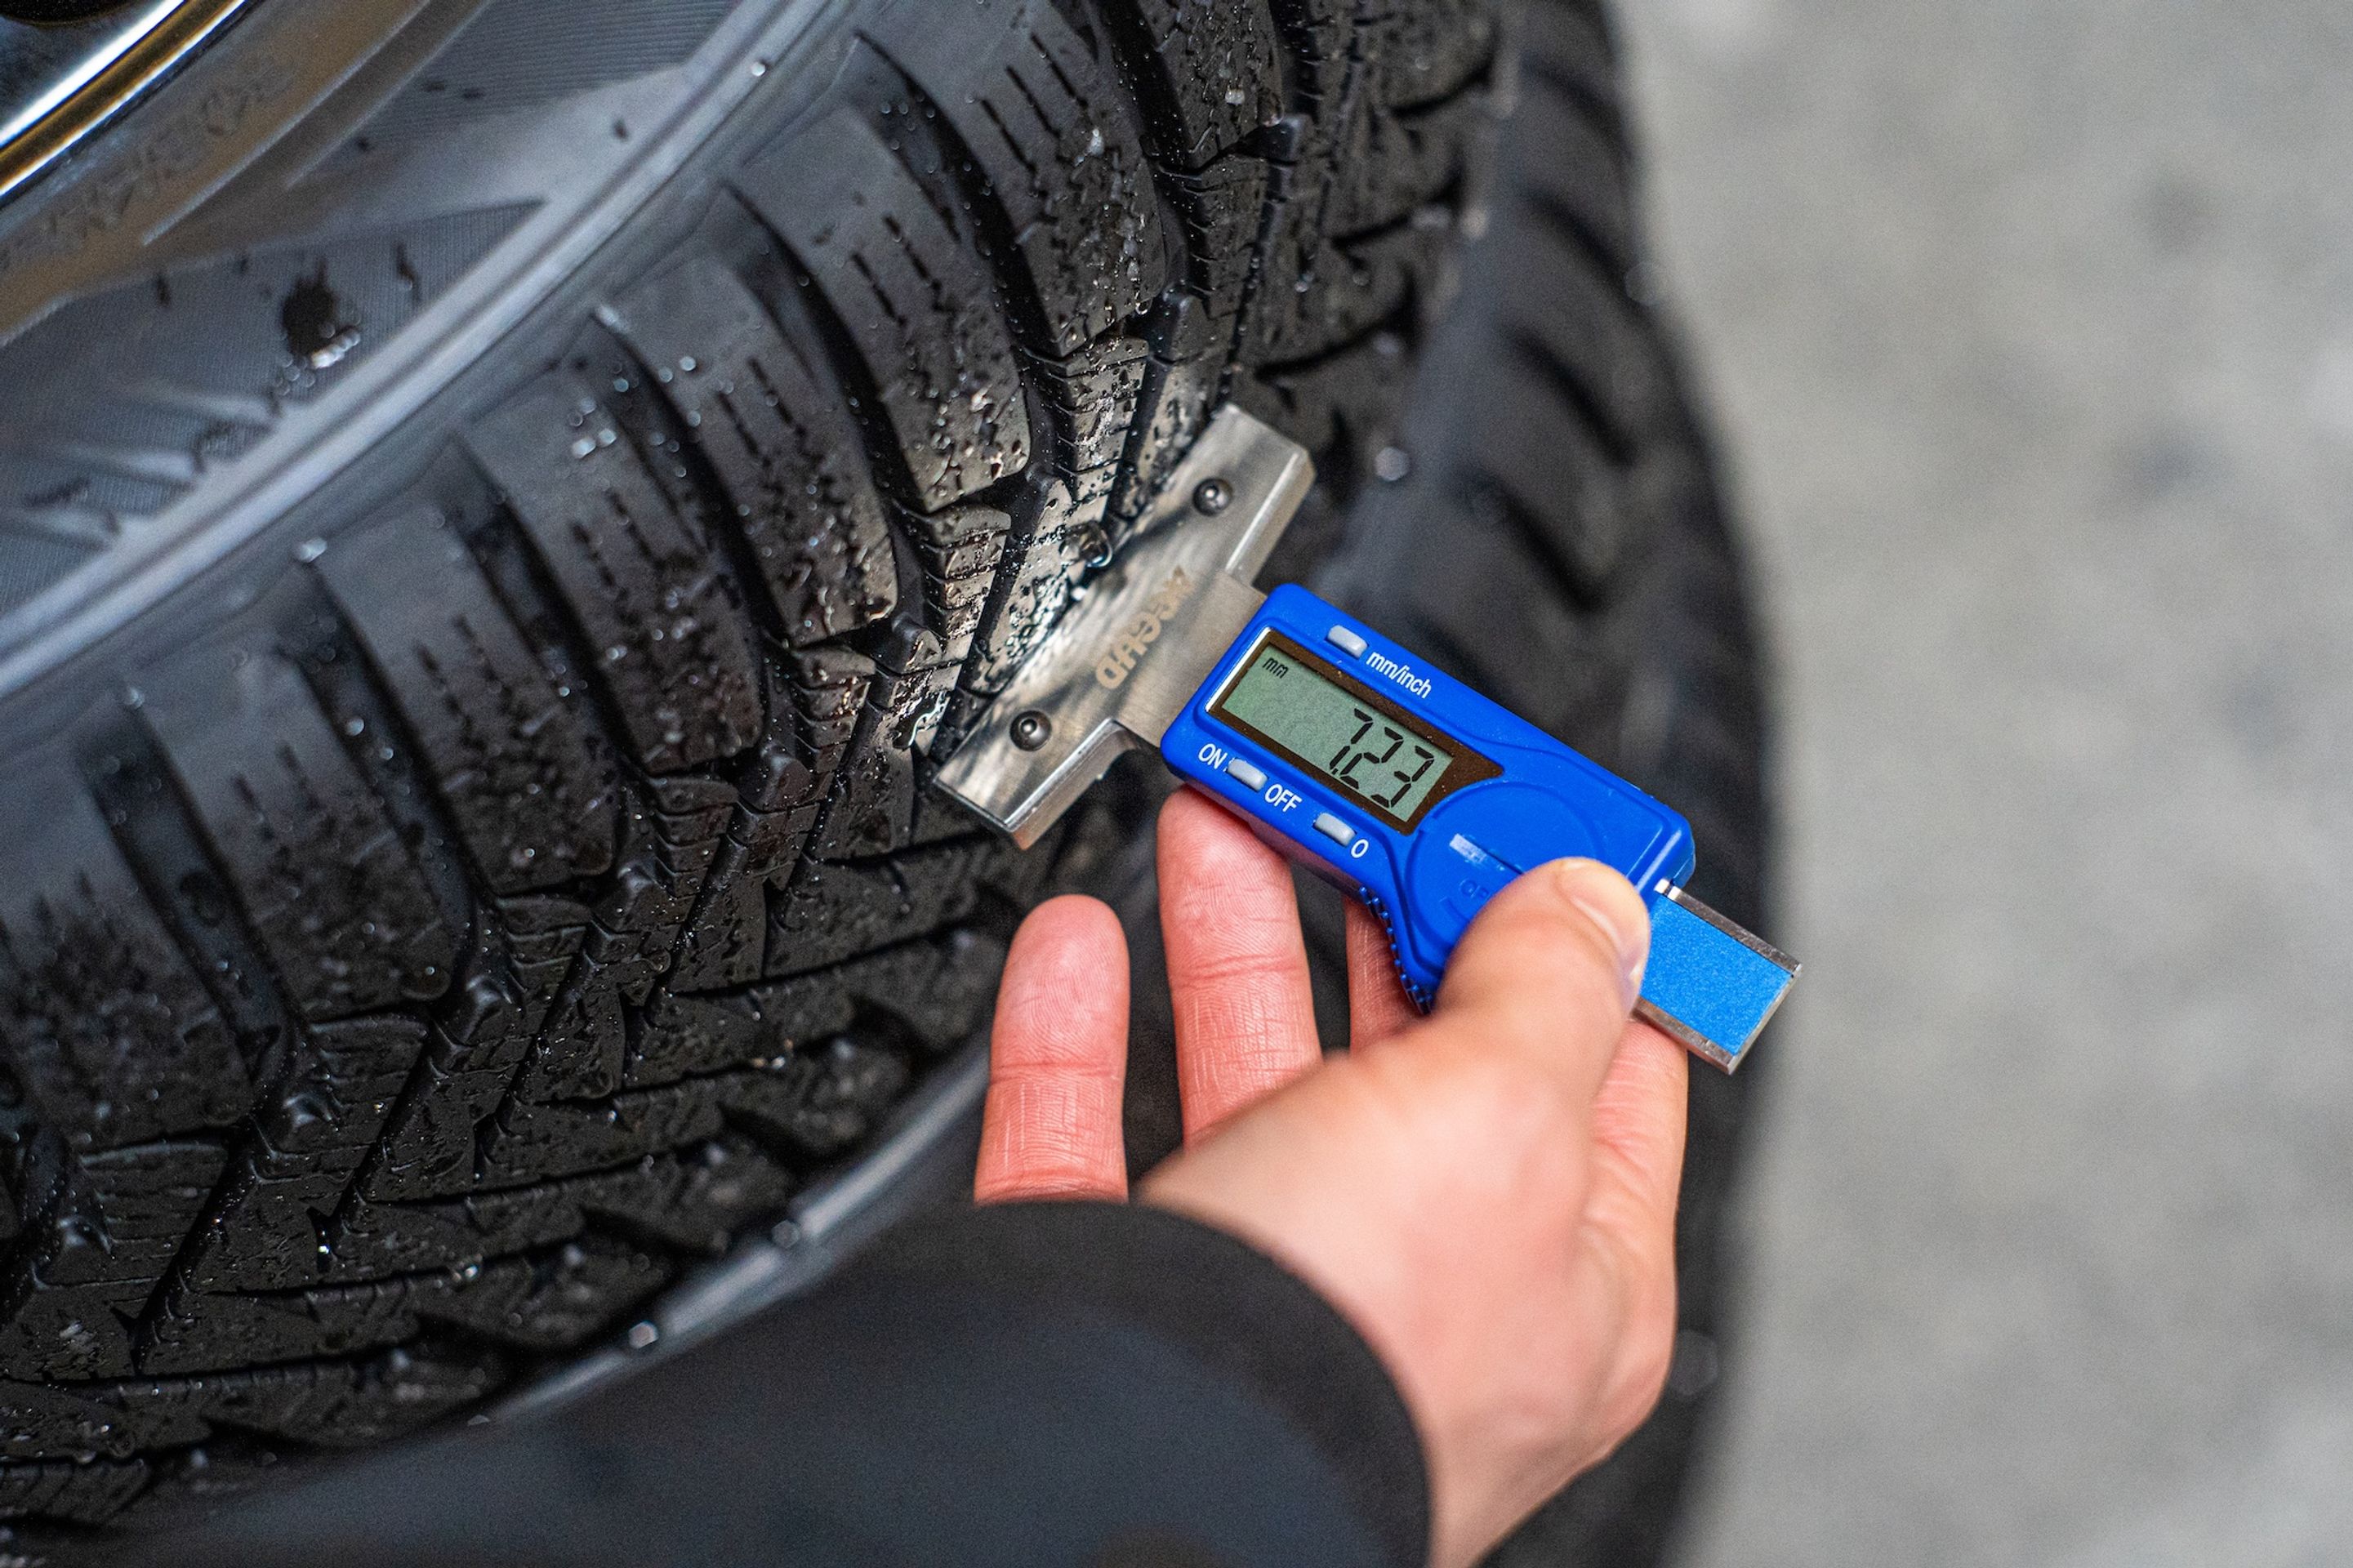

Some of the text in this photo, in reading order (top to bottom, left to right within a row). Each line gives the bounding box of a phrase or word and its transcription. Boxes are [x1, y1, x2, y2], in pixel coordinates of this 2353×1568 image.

[1262, 657, 1289, 679] mm
[1366, 652, 1433, 699] mm/inch
[1330, 708, 1434, 808] 7.23
[1264, 783, 1303, 813] OFF
